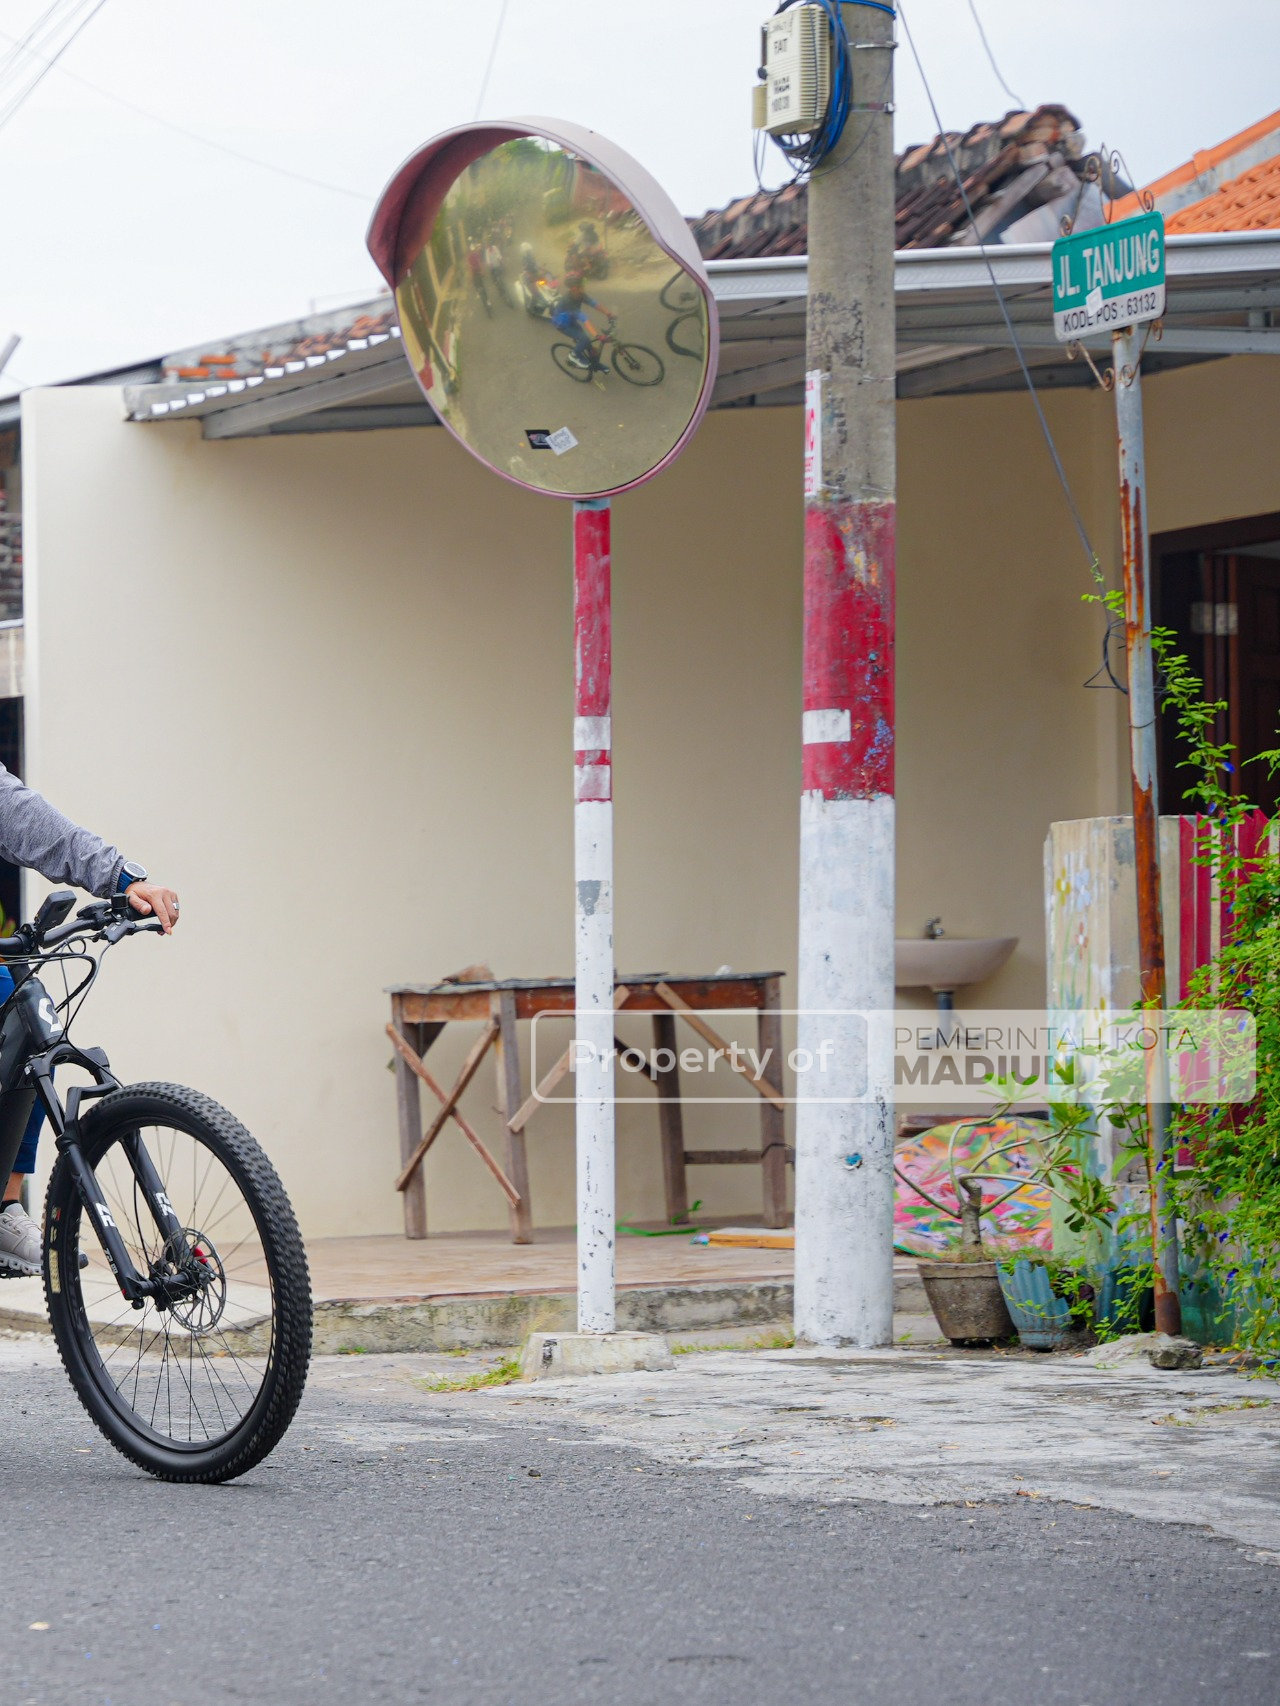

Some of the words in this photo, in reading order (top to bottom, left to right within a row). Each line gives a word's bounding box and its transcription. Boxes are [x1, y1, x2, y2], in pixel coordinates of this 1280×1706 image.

[1057, 255, 1080, 298] JL.
[1083, 229, 1160, 290] TANJUNG
[1096, 302, 1118, 326] POS
[1127, 292, 1156, 316] 63132
